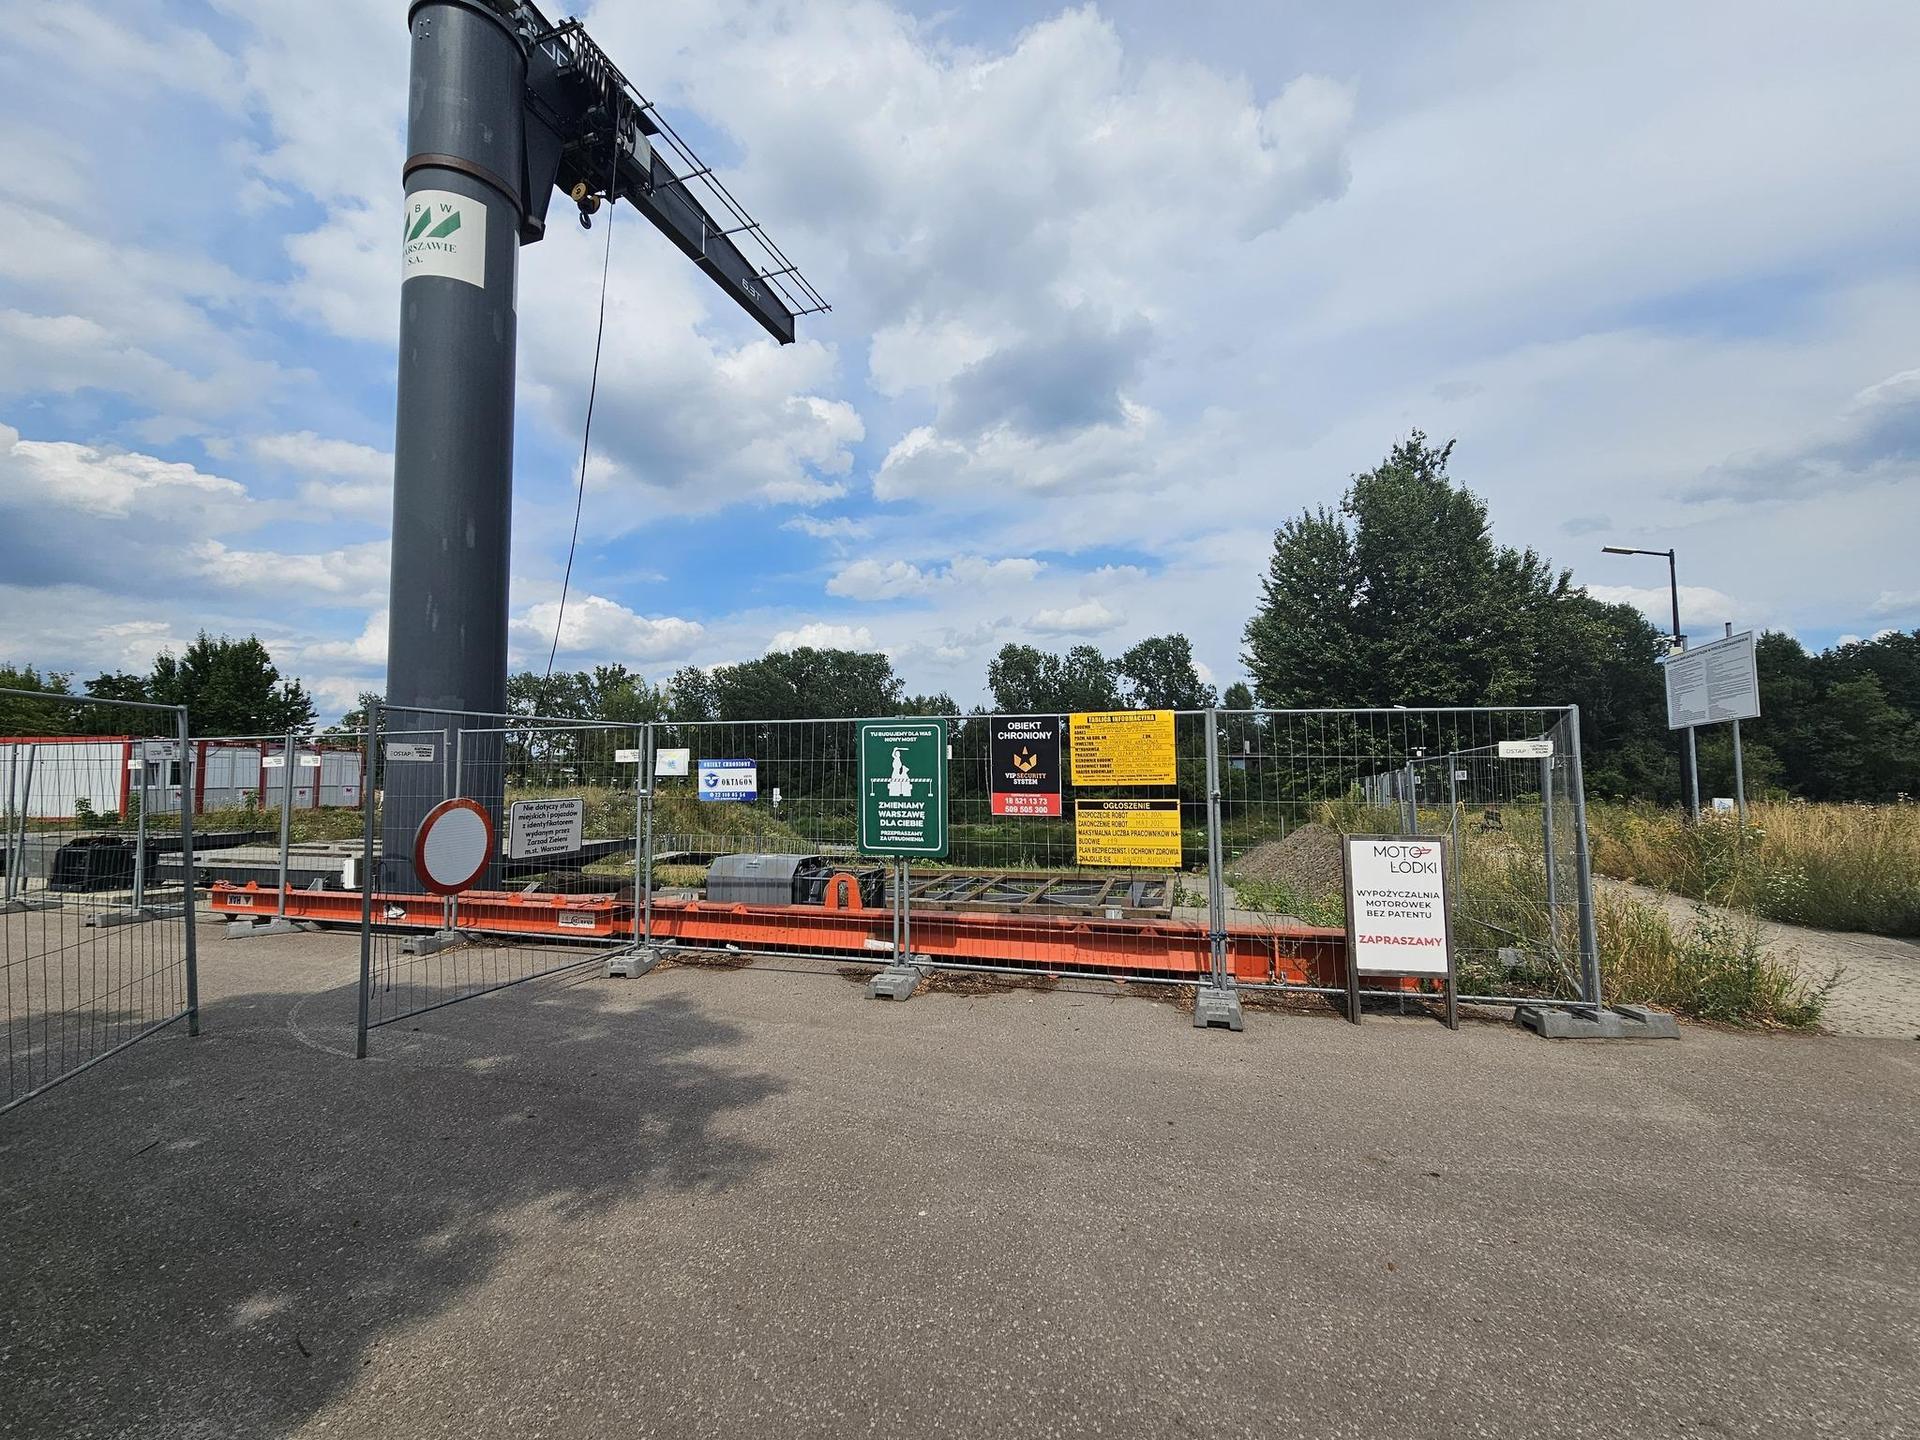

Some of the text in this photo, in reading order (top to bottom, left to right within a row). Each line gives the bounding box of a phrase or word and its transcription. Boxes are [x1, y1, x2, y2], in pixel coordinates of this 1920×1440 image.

[440, 203, 452, 212] W
[998, 731, 1052, 740] CHRONIONY
[518, 812, 546, 820] miejskich
[550, 810, 578, 819] pojazdów
[878, 811, 925, 820] WARSZAWĘ
[527, 820, 573, 828] identyfikatorem
[526, 830, 554, 838] wydanym
[1374, 846, 1422, 858] MOTO
[1390, 858, 1437, 874] ŁÓDKI
[1356, 889, 1440, 898] WYPOŻYCZALNIA
[1366, 900, 1432, 908] MOTORÓWEK
[1359, 935, 1442, 946] ZAPRASZAMY
